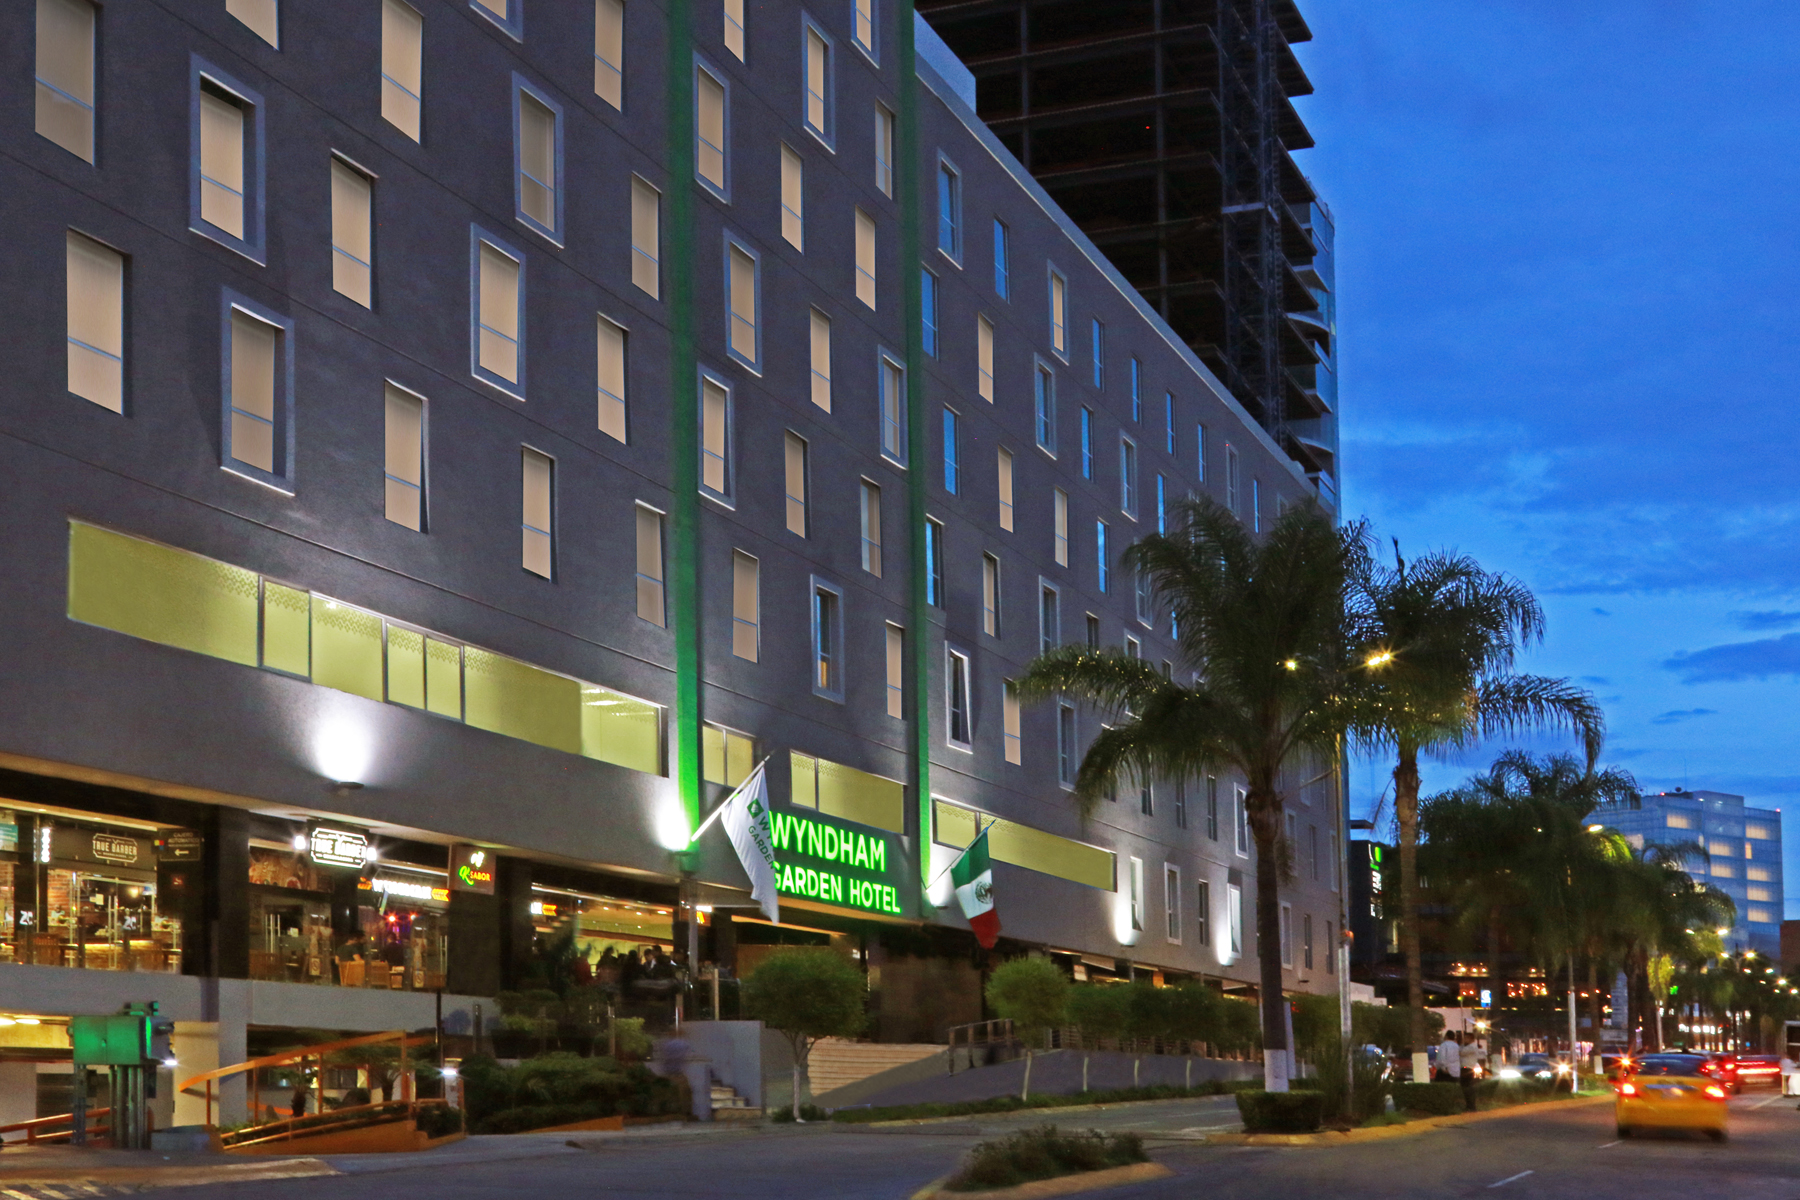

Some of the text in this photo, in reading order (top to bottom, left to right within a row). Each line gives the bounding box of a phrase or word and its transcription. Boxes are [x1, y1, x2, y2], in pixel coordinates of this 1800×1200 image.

[92, 840, 110, 852] TRUE
[111, 843, 138, 856] BARBER
[768, 810, 886, 873] WYNDHAM
[773, 861, 901, 913] GARDEN HOTEL
